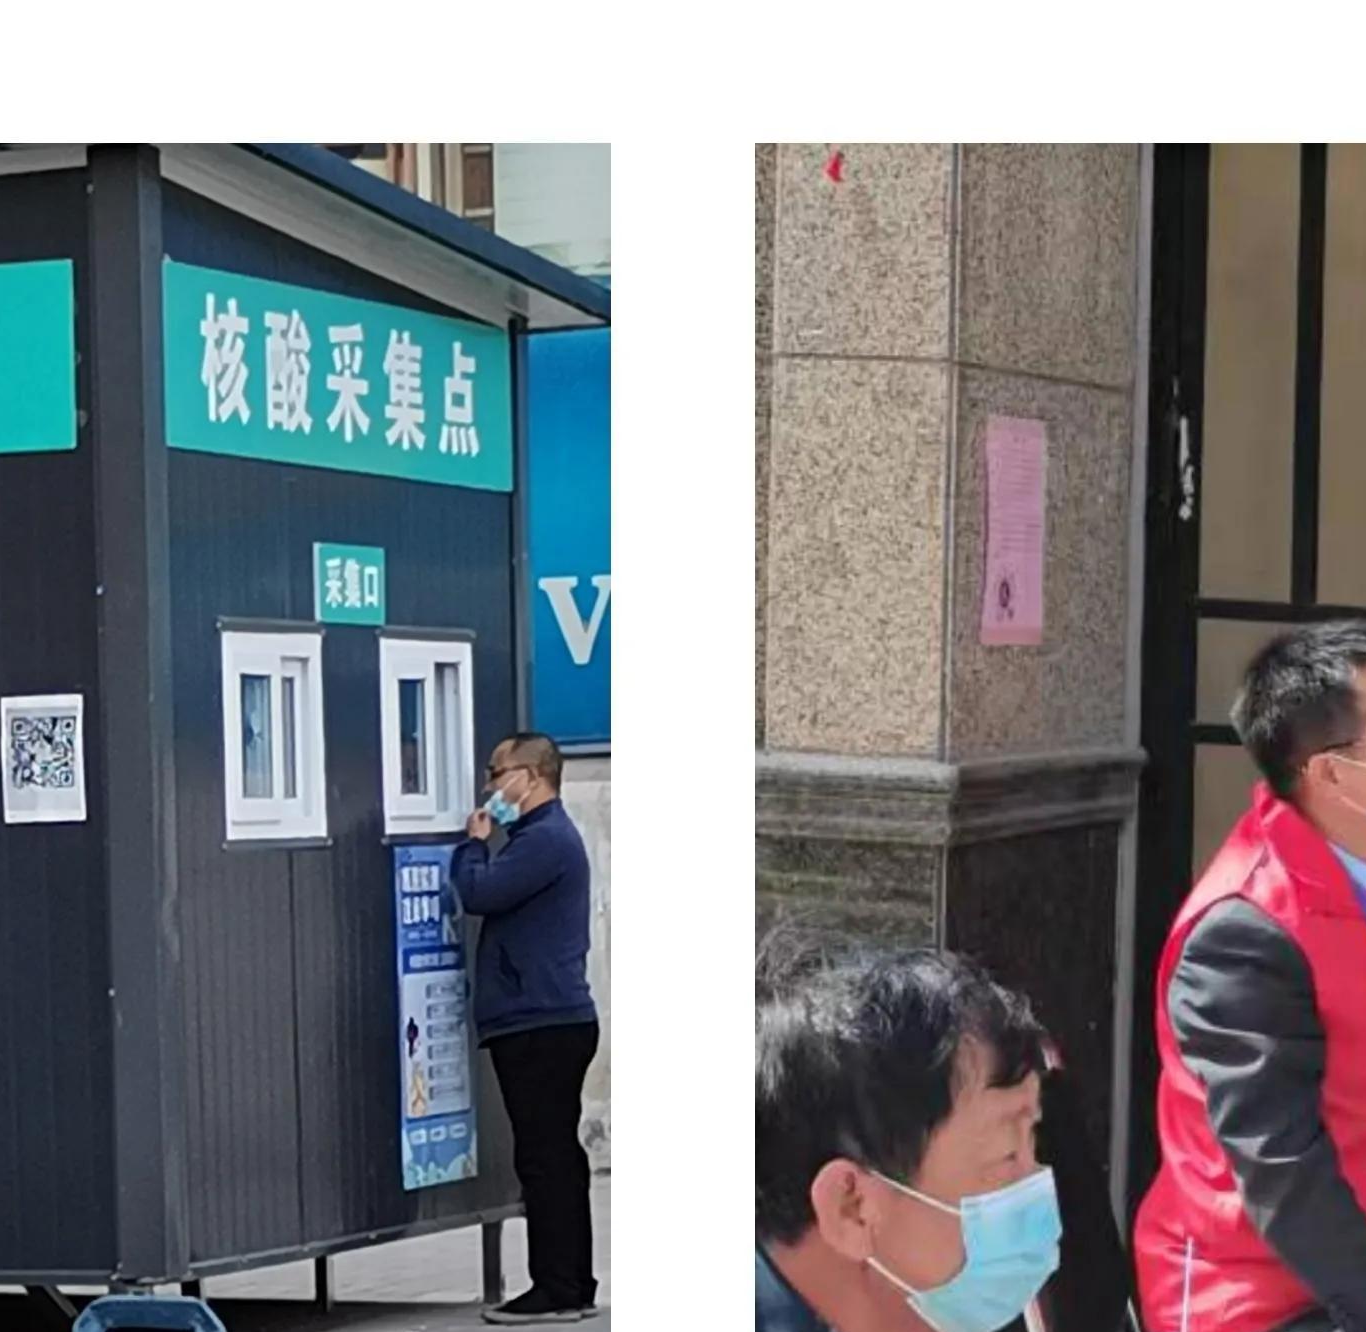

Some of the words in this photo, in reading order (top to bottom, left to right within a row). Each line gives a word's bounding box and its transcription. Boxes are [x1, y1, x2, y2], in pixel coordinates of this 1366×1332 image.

[199, 293, 480, 458] 核酸采集点
[324, 556, 379, 609] 采集口
